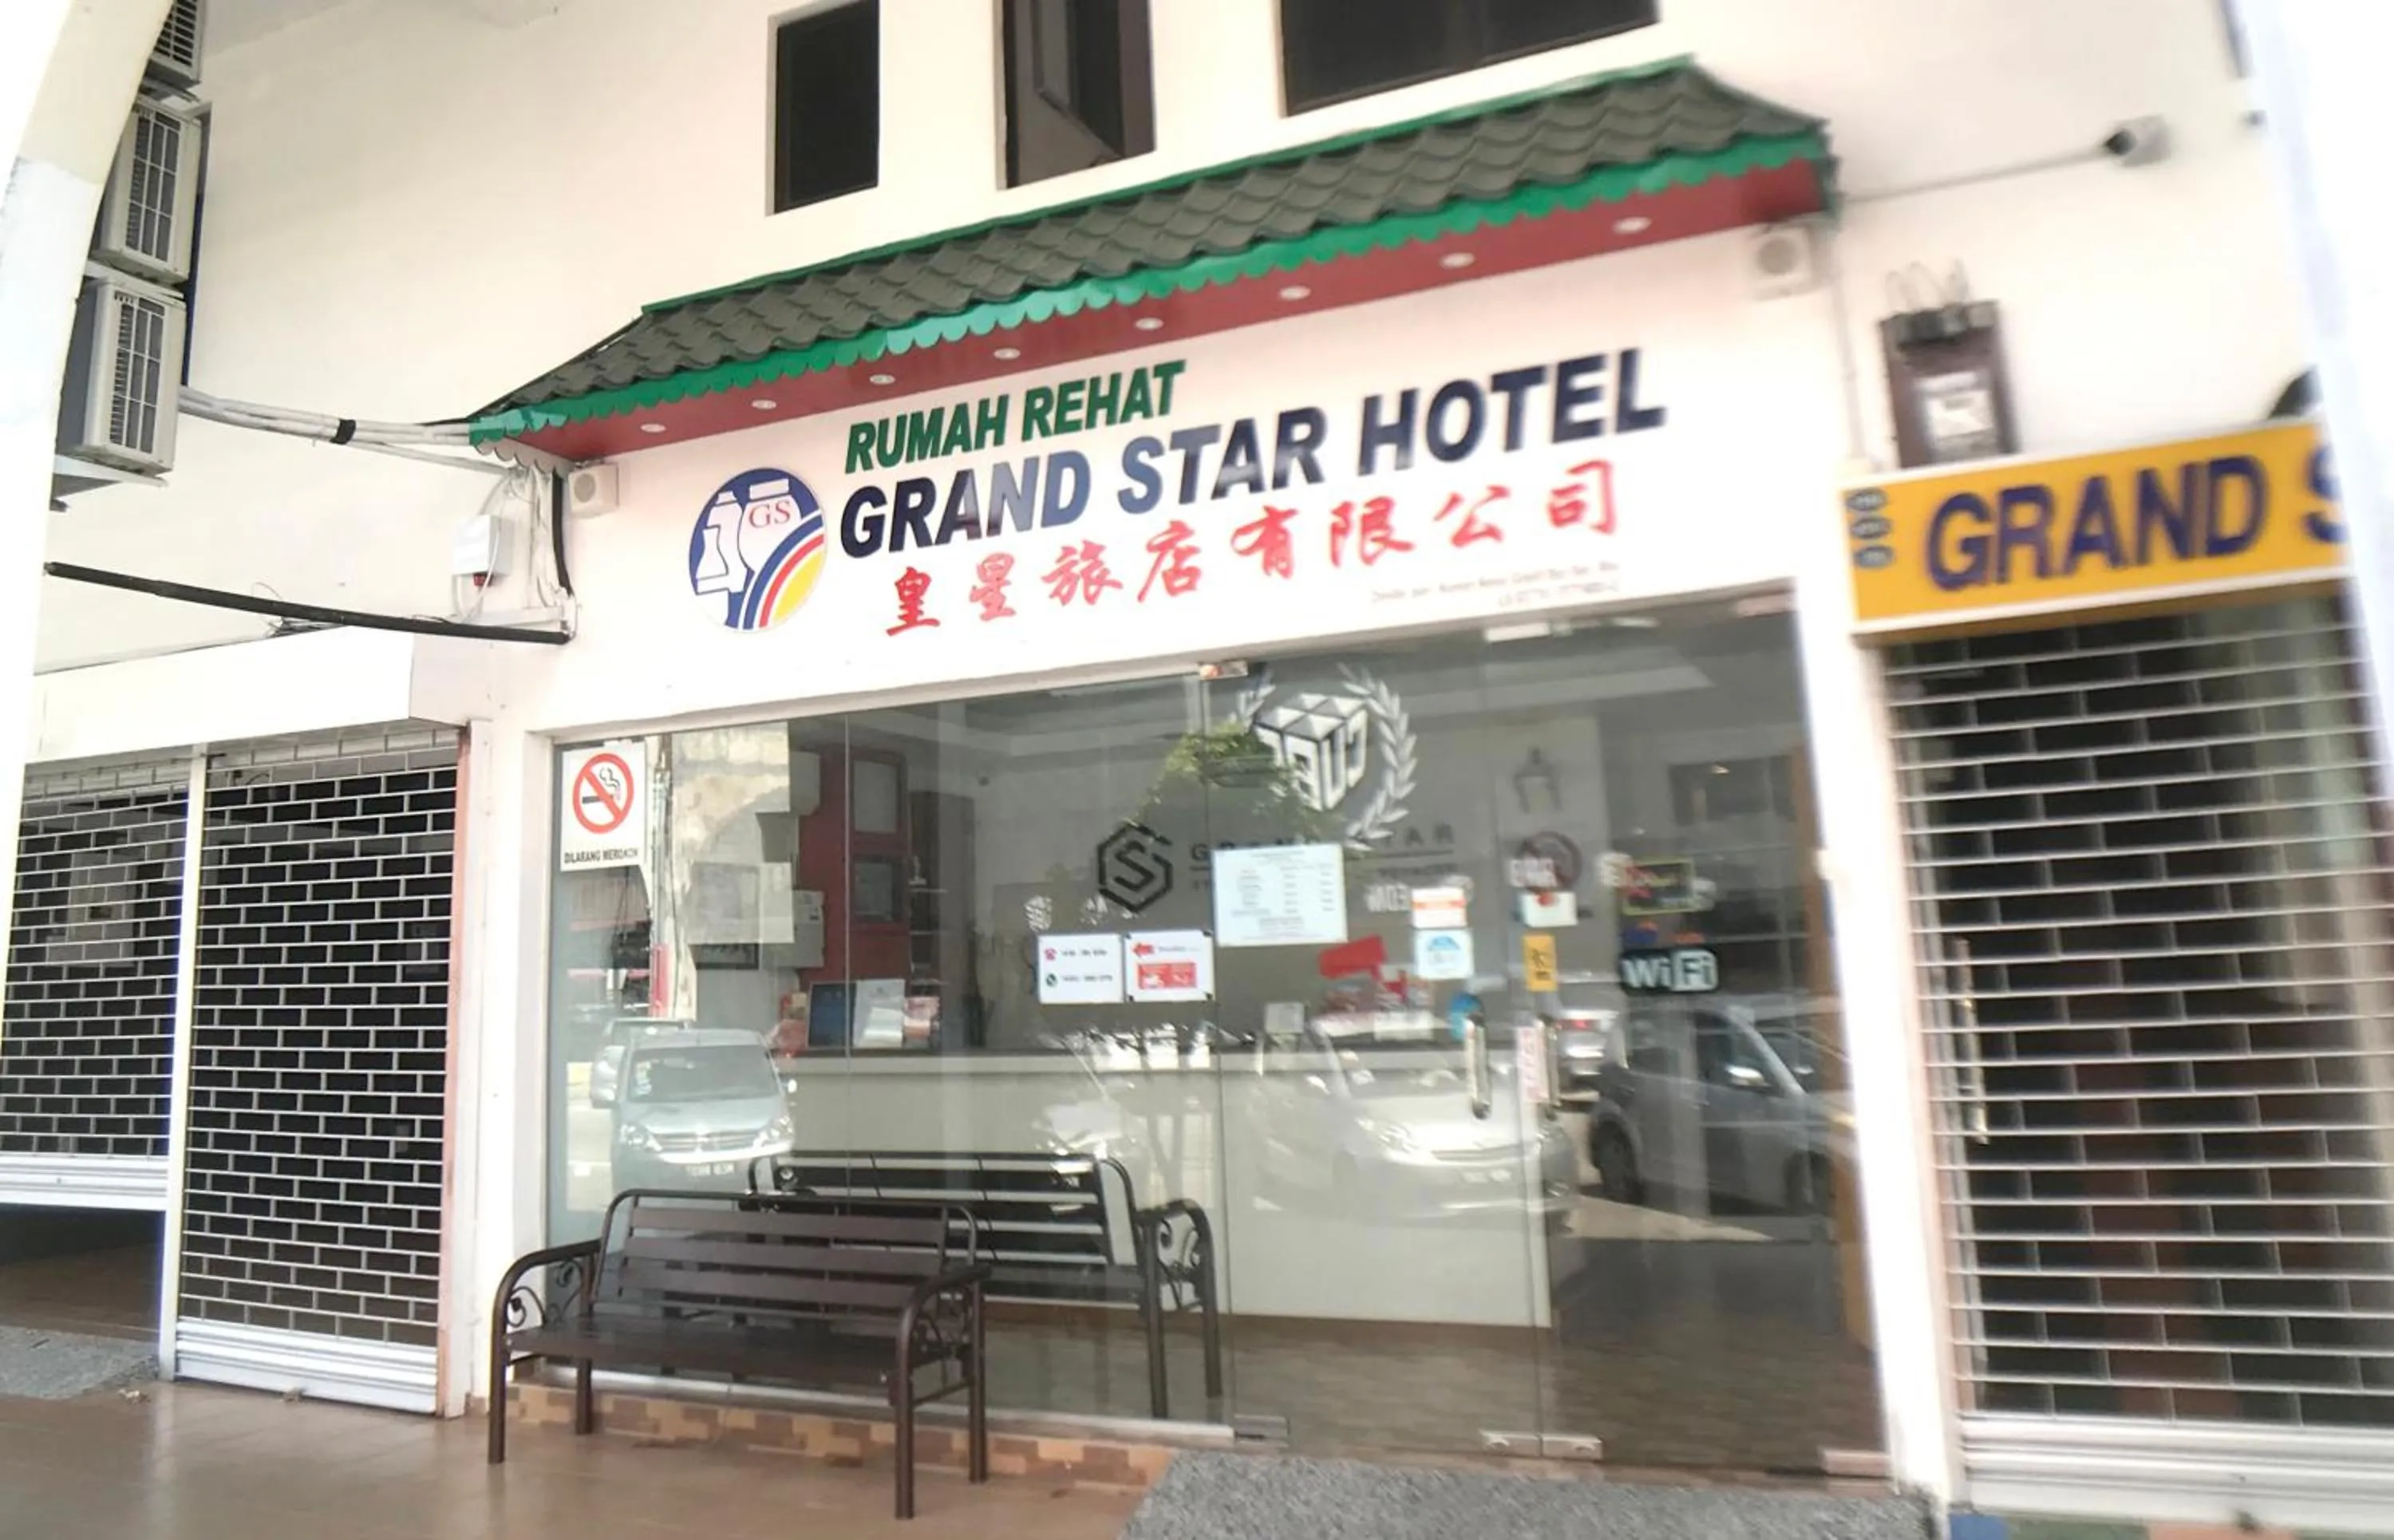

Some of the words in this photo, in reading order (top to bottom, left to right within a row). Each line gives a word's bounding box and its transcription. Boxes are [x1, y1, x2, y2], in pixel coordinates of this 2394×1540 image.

[839, 449, 1091, 559] GRAND
[1117, 406, 1326, 515] STAR
[1358, 348, 1666, 476] HOTEL
[844, 394, 1009, 474] RUMAH
[1021, 360, 1186, 441] REHAT
[749, 500, 792, 529] GS
[886, 459, 1617, 637] 皇星旅店有限公司
[1926, 454, 2268, 590] GRAND
